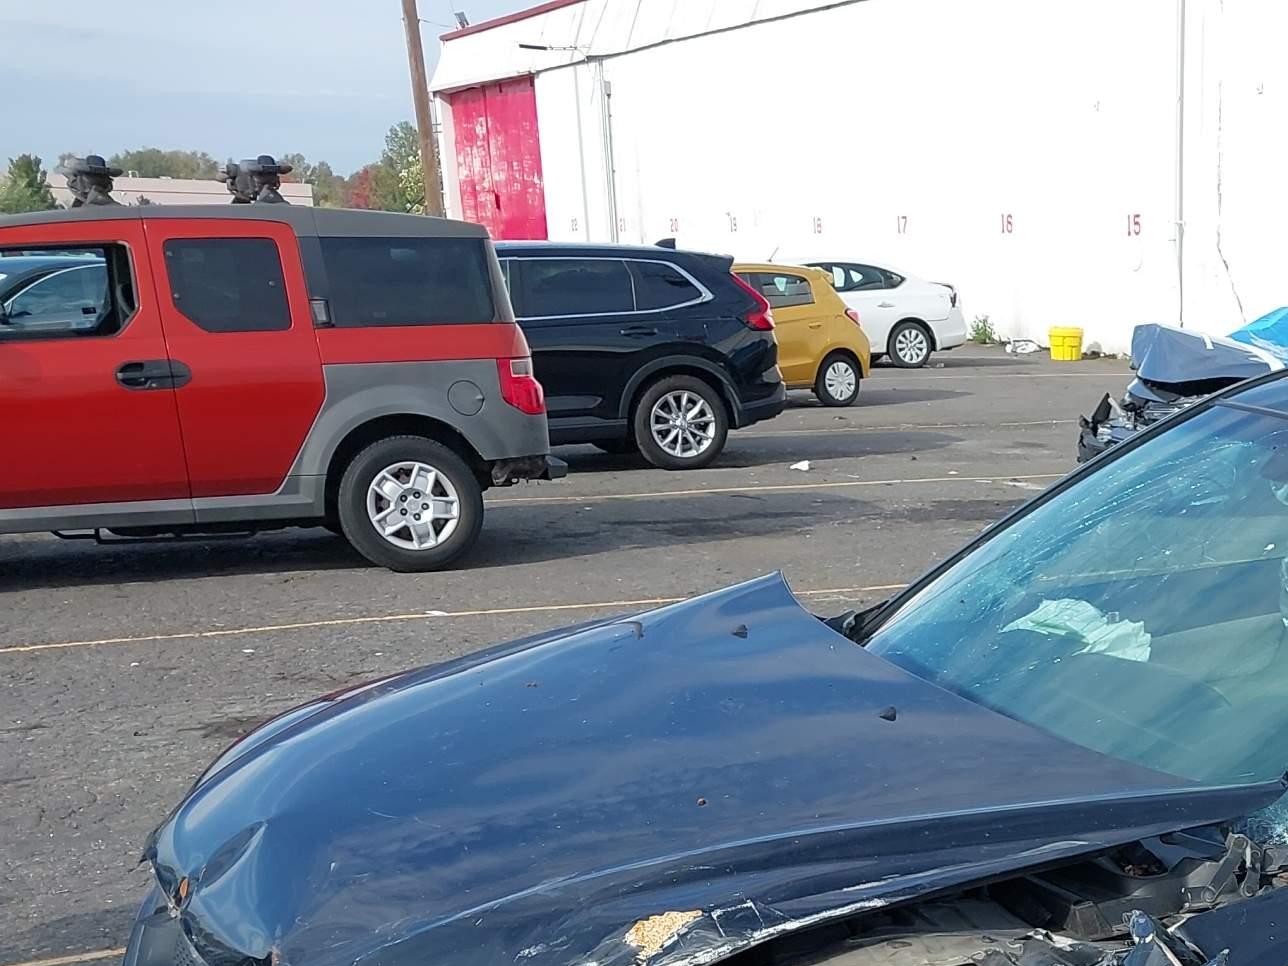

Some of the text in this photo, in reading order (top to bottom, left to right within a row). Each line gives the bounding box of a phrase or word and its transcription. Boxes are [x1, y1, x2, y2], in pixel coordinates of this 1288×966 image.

[669, 217, 679, 233] 20
[897, 215, 908, 234] 17
[1000, 213, 1013, 235] 16
[1127, 213, 1141, 237] 15
